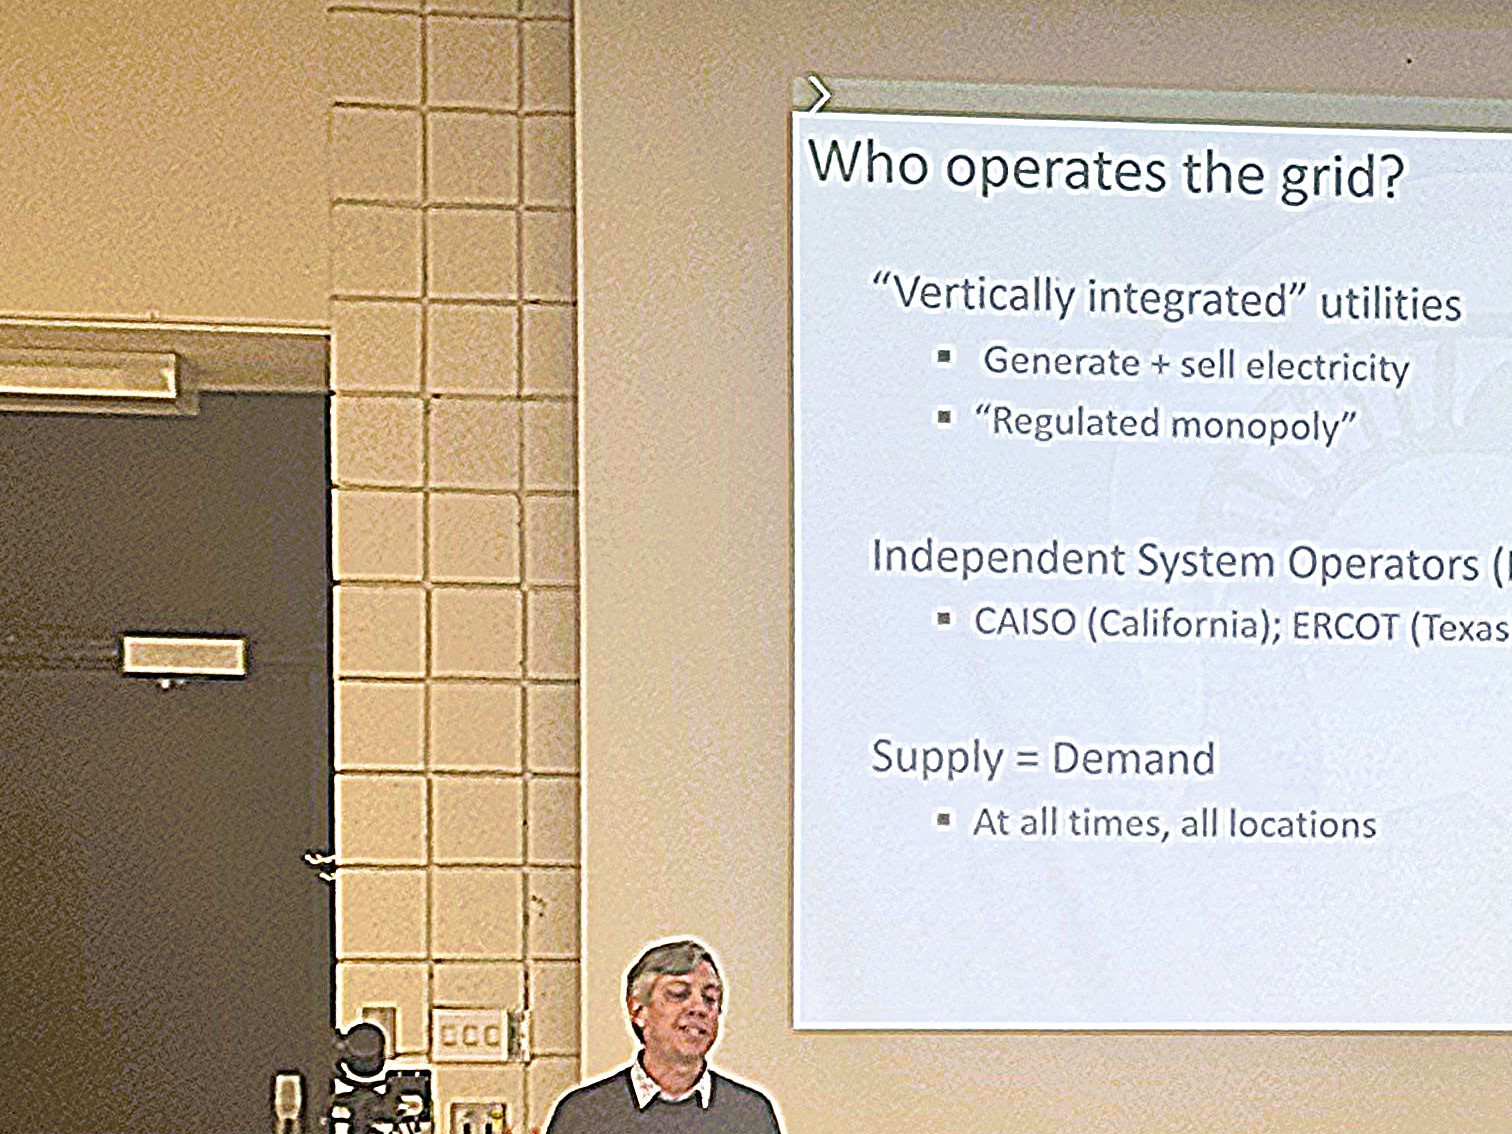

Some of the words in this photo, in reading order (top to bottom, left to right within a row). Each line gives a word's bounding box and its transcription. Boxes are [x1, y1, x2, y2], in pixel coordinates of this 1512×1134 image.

[808, 139, 927, 184] Who
[947, 152, 1166, 197] operates
[1183, 149, 1264, 194] the
[1282, 154, 1404, 206] grid?
[1322, 285, 1461, 321] utilities
[985, 346, 1139, 376] Generate
[1152, 355, 1169, 374] +
[1181, 349, 1233, 378] sell
[1247, 350, 1409, 388] electricity
[875, 538, 1125, 580] Independent
[1139, 543, 1273, 583] System
[1290, 546, 1479, 586] Operators
[976, 607, 1075, 635] CAISO
[1089, 607, 1280, 645] (California);
[1295, 612, 1399, 640] ERCOT
[873, 739, 1003, 780] Supply
[1018, 752, 1037, 766] =
[1055, 742, 1213, 775] Demand
[974, 809, 1008, 835] At
[1021, 806, 1056, 835] all
[1070, 808, 1168, 842] times,
[1182, 808, 1216, 836] all
[1231, 809, 1376, 838] locations
